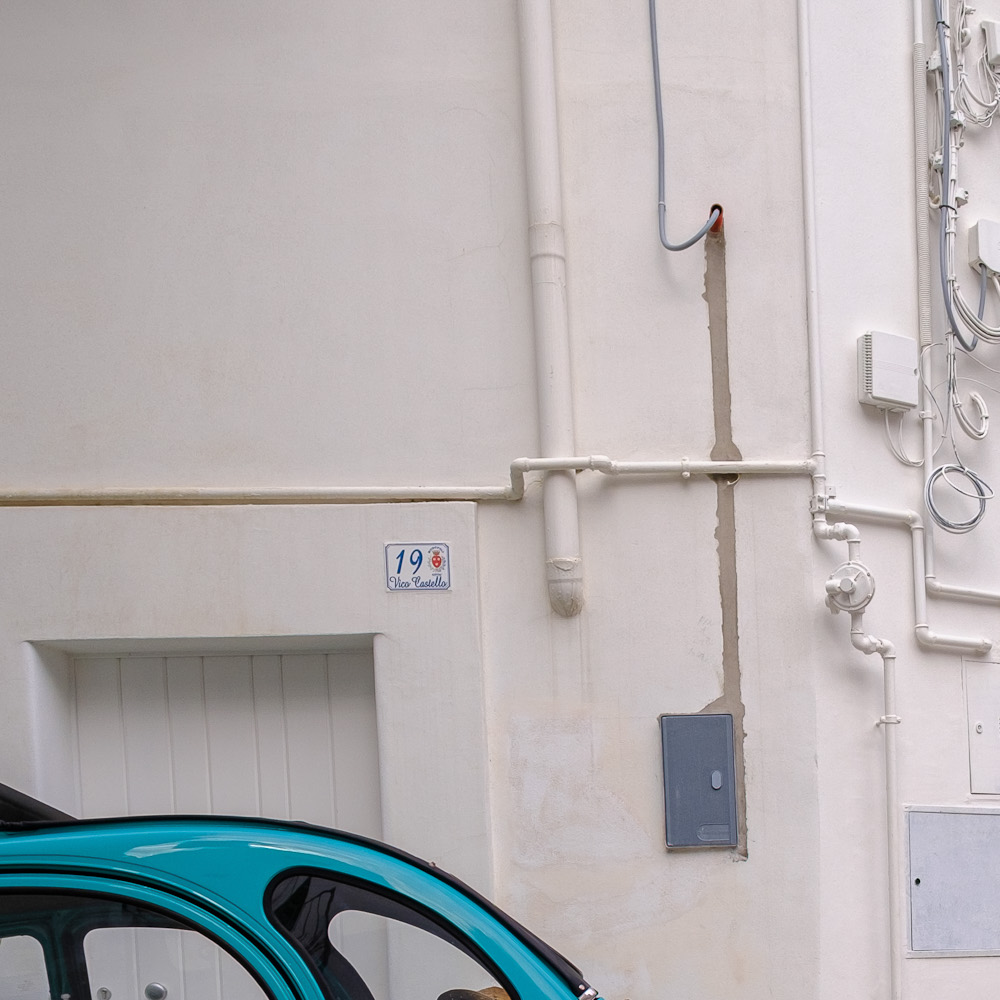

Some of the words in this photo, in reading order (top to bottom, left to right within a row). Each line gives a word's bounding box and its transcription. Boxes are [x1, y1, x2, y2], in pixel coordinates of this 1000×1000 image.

[396, 549, 423, 575] 19
[389, 576, 411, 588] Vico
[411, 575, 447, 588] Castello
